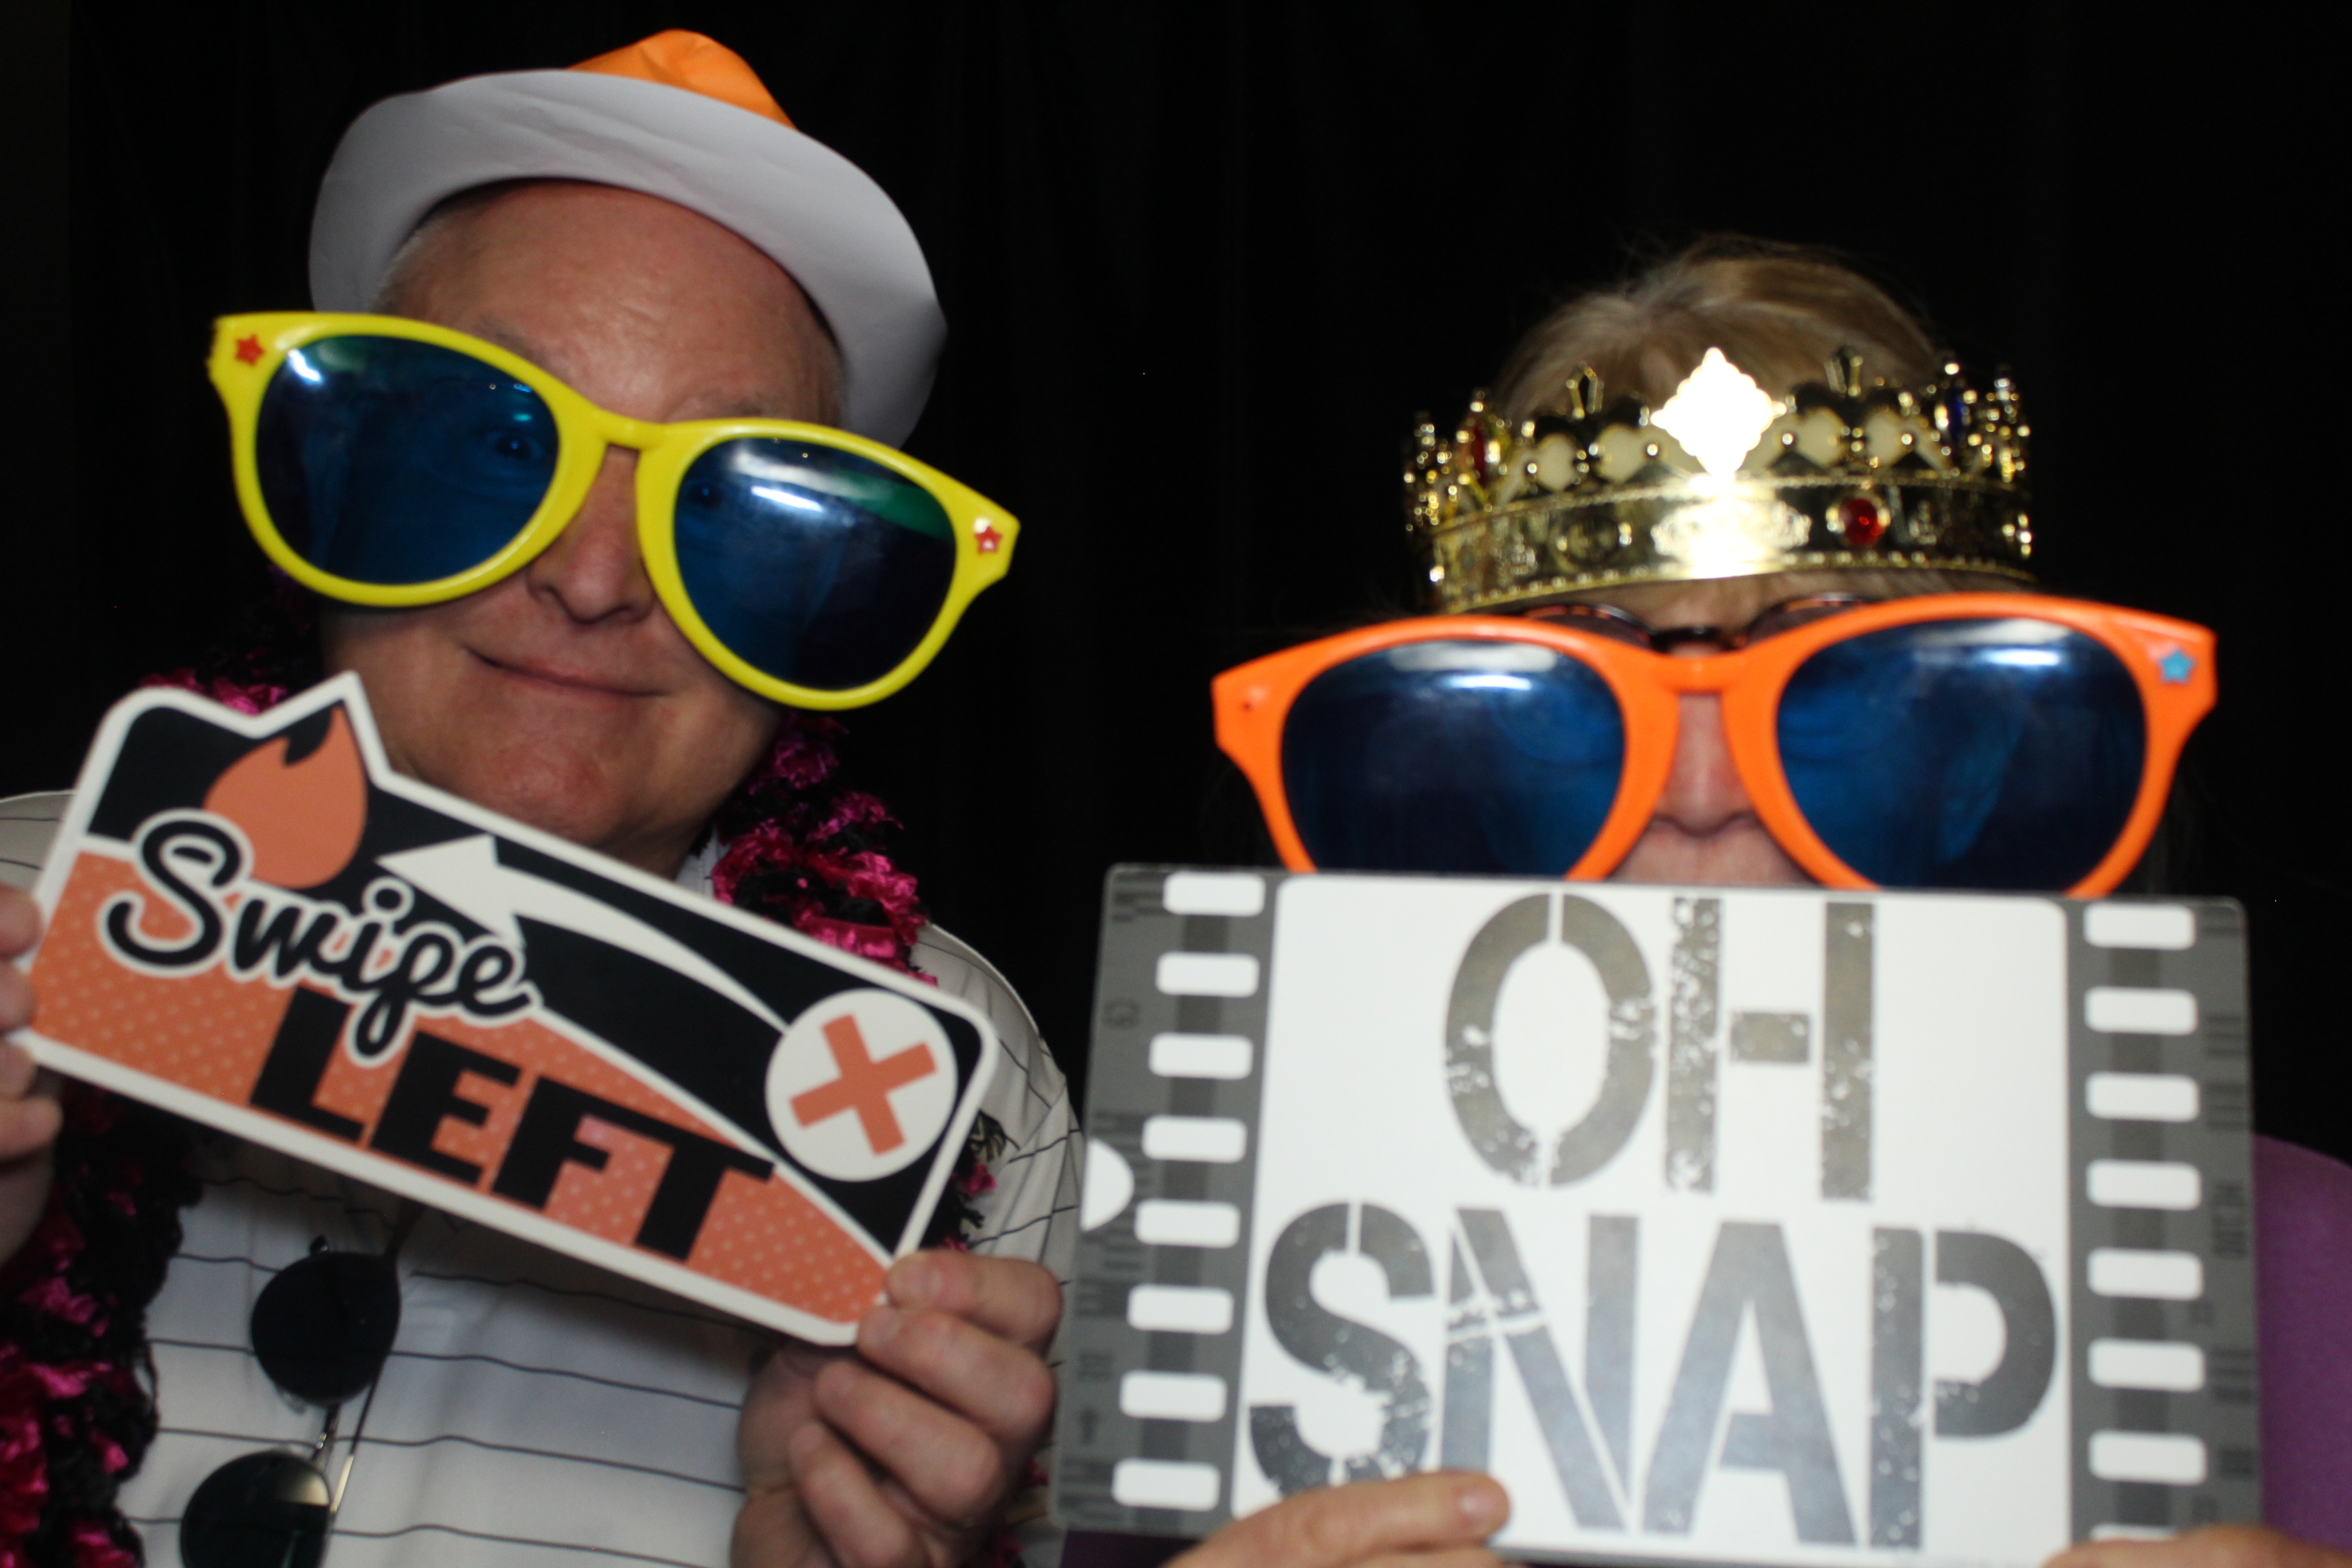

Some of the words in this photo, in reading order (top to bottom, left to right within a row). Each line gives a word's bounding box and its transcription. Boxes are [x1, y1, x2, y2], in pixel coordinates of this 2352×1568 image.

[105, 820, 531, 1054] Swipe
[1445, 892, 1877, 1202] OH
[250, 986, 775, 1262] LEFT
[1249, 1201, 2058, 1551] SNAP
